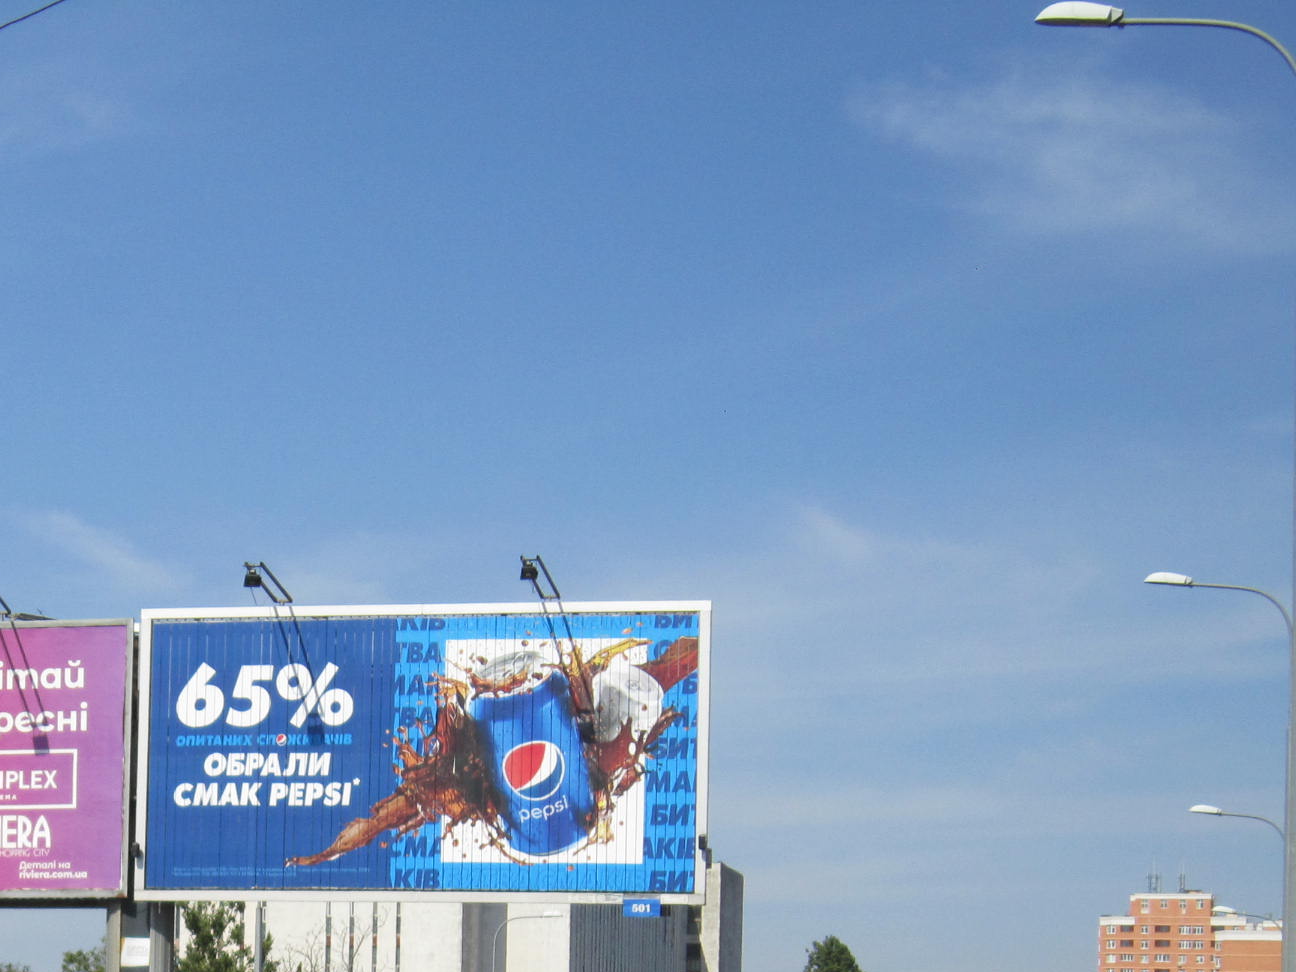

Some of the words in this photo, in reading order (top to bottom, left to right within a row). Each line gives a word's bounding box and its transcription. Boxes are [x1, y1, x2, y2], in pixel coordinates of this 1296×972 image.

[176, 662, 354, 728] 65%
[176, 734, 253, 747] ОПИТАНИХ
[257, 733, 353, 747] СПОЖИАЧІВ
[204, 752, 332, 777] ОБРАЛИ
[173, 782, 263, 807] СМАК
[519, 795, 568, 823] pepsi
[19, 860, 56, 870] Деталі
[58, 861, 71, 869] на
[19, 870, 88, 880] riviera.com.ua
[631, 903, 651, 912] 501
